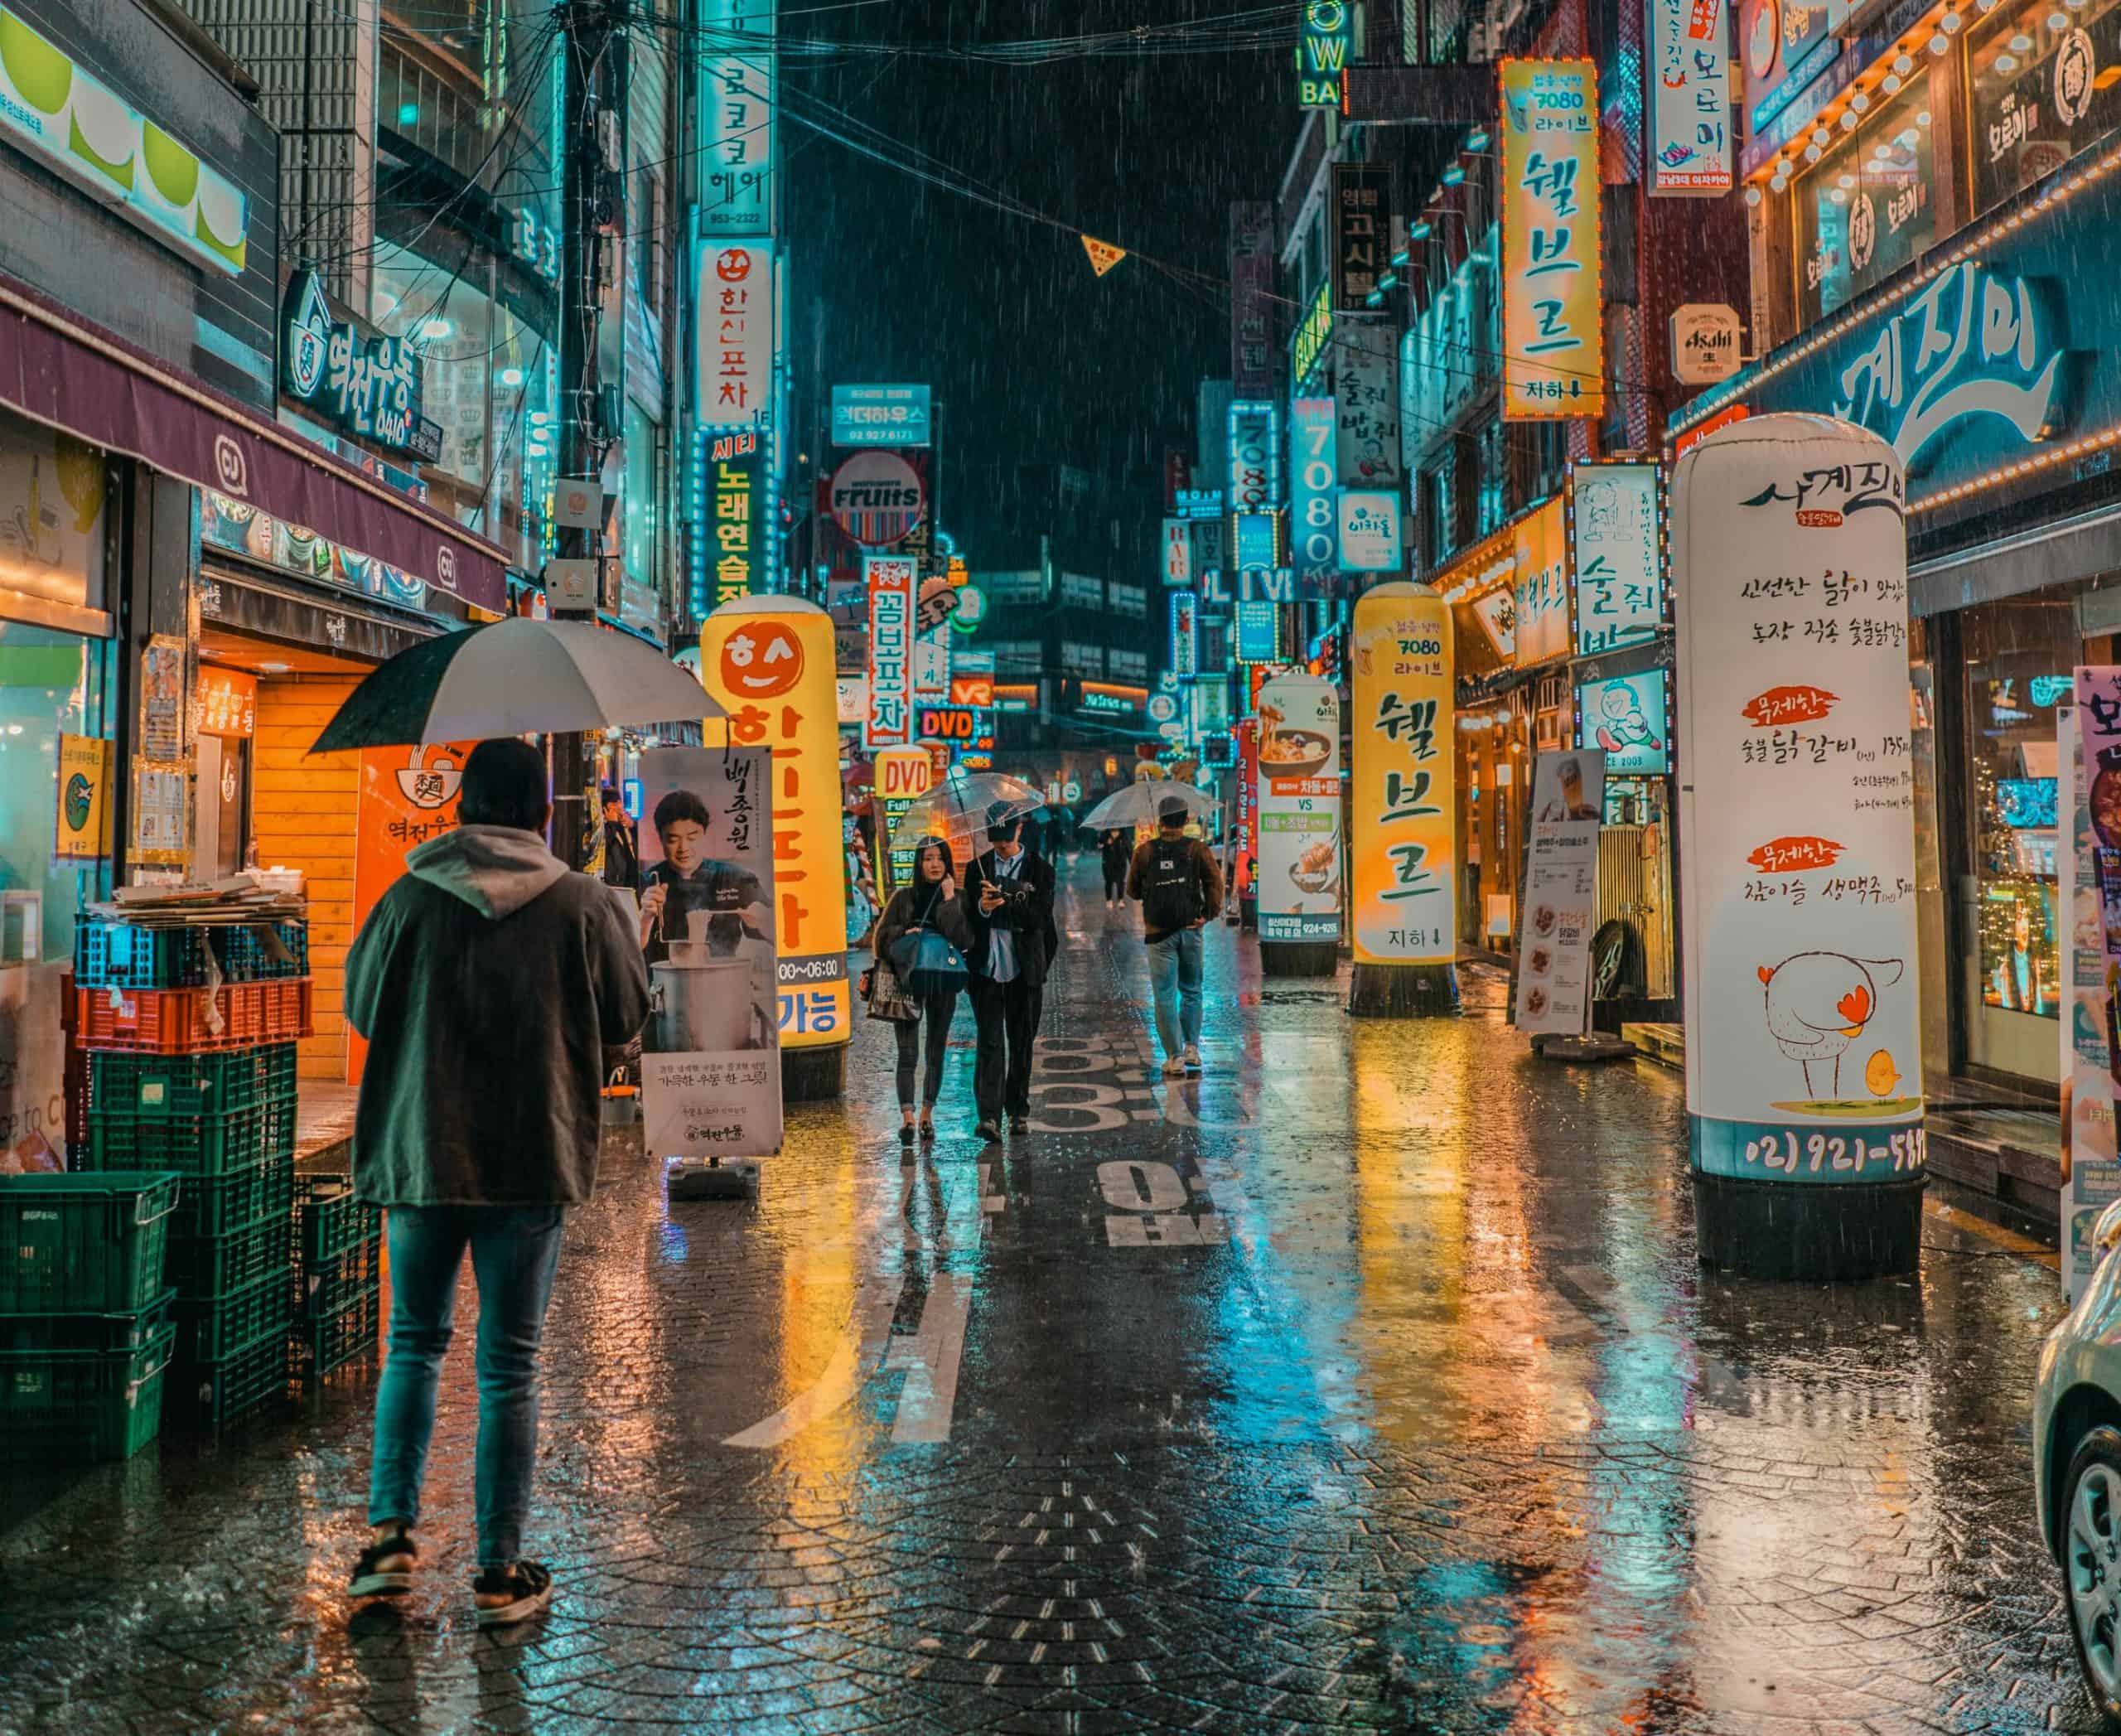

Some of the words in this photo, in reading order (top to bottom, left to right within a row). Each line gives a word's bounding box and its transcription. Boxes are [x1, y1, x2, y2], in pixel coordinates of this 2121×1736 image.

[1301, 80, 1341, 104] BA
[1534, 92, 1583, 109] 7080
[1535, 115, 1592, 133] 라이브
[710, 172, 761, 205] 헤어
[1521, 152, 1580, 352] 쉘브르
[718, 288, 749, 409] 한신포차
[1684, 330, 1732, 349] Asahi
[1833, 262, 2063, 468] 계진미
[1525, 381, 1563, 399] 지하
[711, 431, 756, 462] 시티
[835, 487, 919, 509] Fruits
[1305, 426, 1333, 563] 7080
[1742, 577, 1810, 598] 신선한
[1752, 621, 1795, 644] 농장
[1804, 620, 1838, 644] 직송
[1849, 619, 1906, 646] 숯불닭갈
[1397, 640, 1441, 655] 7080
[1394, 662, 1443, 676] 라이브
[954, 682, 991, 704] VR
[1757, 690, 1824, 725] 무제한
[922, 710, 974, 738] DVD
[885, 760, 928, 793] DVD
[723, 757, 752, 851] 백종원
[1298, 799, 1312, 811] VS
[1375, 693, 1442, 900] 쉘브르
[389, 816, 458, 844] 역전우
[1763, 841, 1831, 872] 무제한
[1744, 879, 1806, 906] 참이슬
[1823, 875, 1882, 906] 생맥주
[1388, 929, 1425, 948] 지하
[777, 991, 837, 1034] 가능
[697, 1073, 721, 1087] 우동
[726, 1073, 736, 1085] 한
